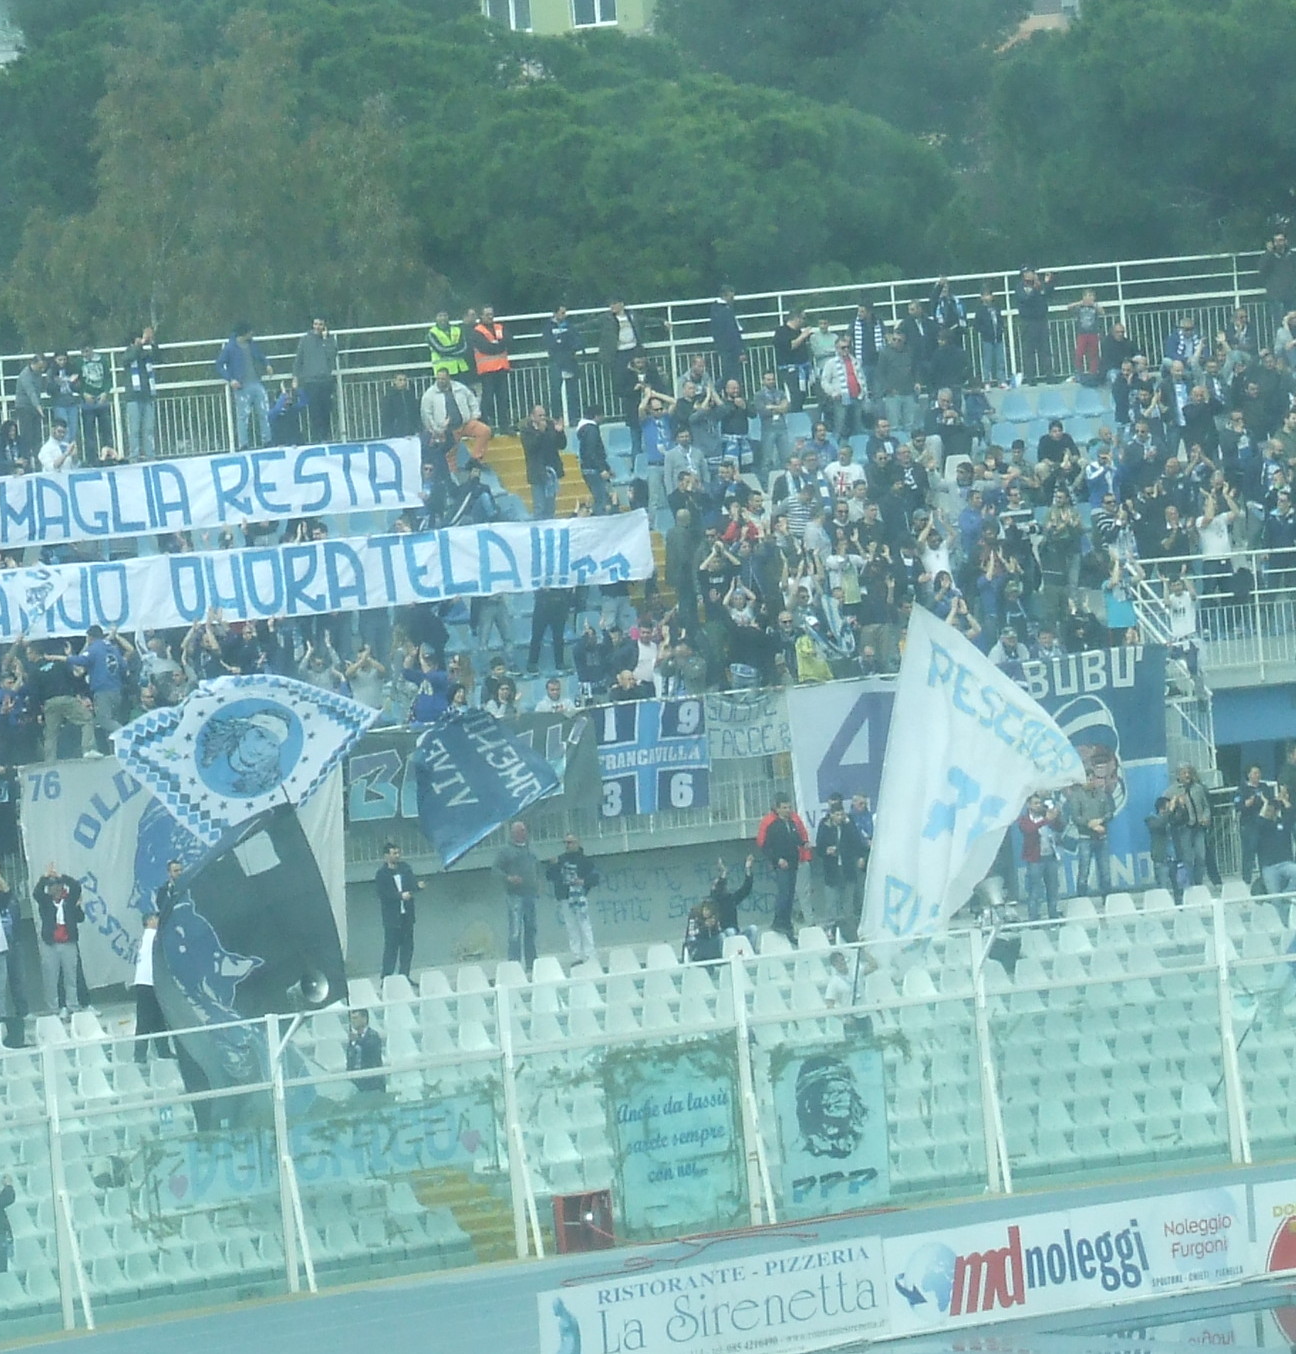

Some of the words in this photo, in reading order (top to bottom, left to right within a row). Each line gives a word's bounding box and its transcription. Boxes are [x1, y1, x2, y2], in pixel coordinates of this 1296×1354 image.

[0, 463, 192, 542] MAGLIA
[211, 443, 406, 521] RESTA
[604, 706, 617, 741] 1
[677, 701, 700, 734] 9
[28, 770, 61, 802] 76
[603, 781, 622, 817] 3
[670, 773, 694, 808] 6
[618, 1098, 660, 1125] Anche
[663, 1095, 684, 1115] da
[673, 1126, 726, 1150] sempre
[648, 1168, 673, 1183] con
[1164, 1213, 1232, 1237] Noleggio
[1172, 1235, 1228, 1259] Furgoni
[598, 1265, 745, 1305] RISTORANTE
[766, 1245, 870, 1277] PIZZERIA
[601, 1308, 646, 1354] La
[666, 1271, 880, 1343] Sirenetta
